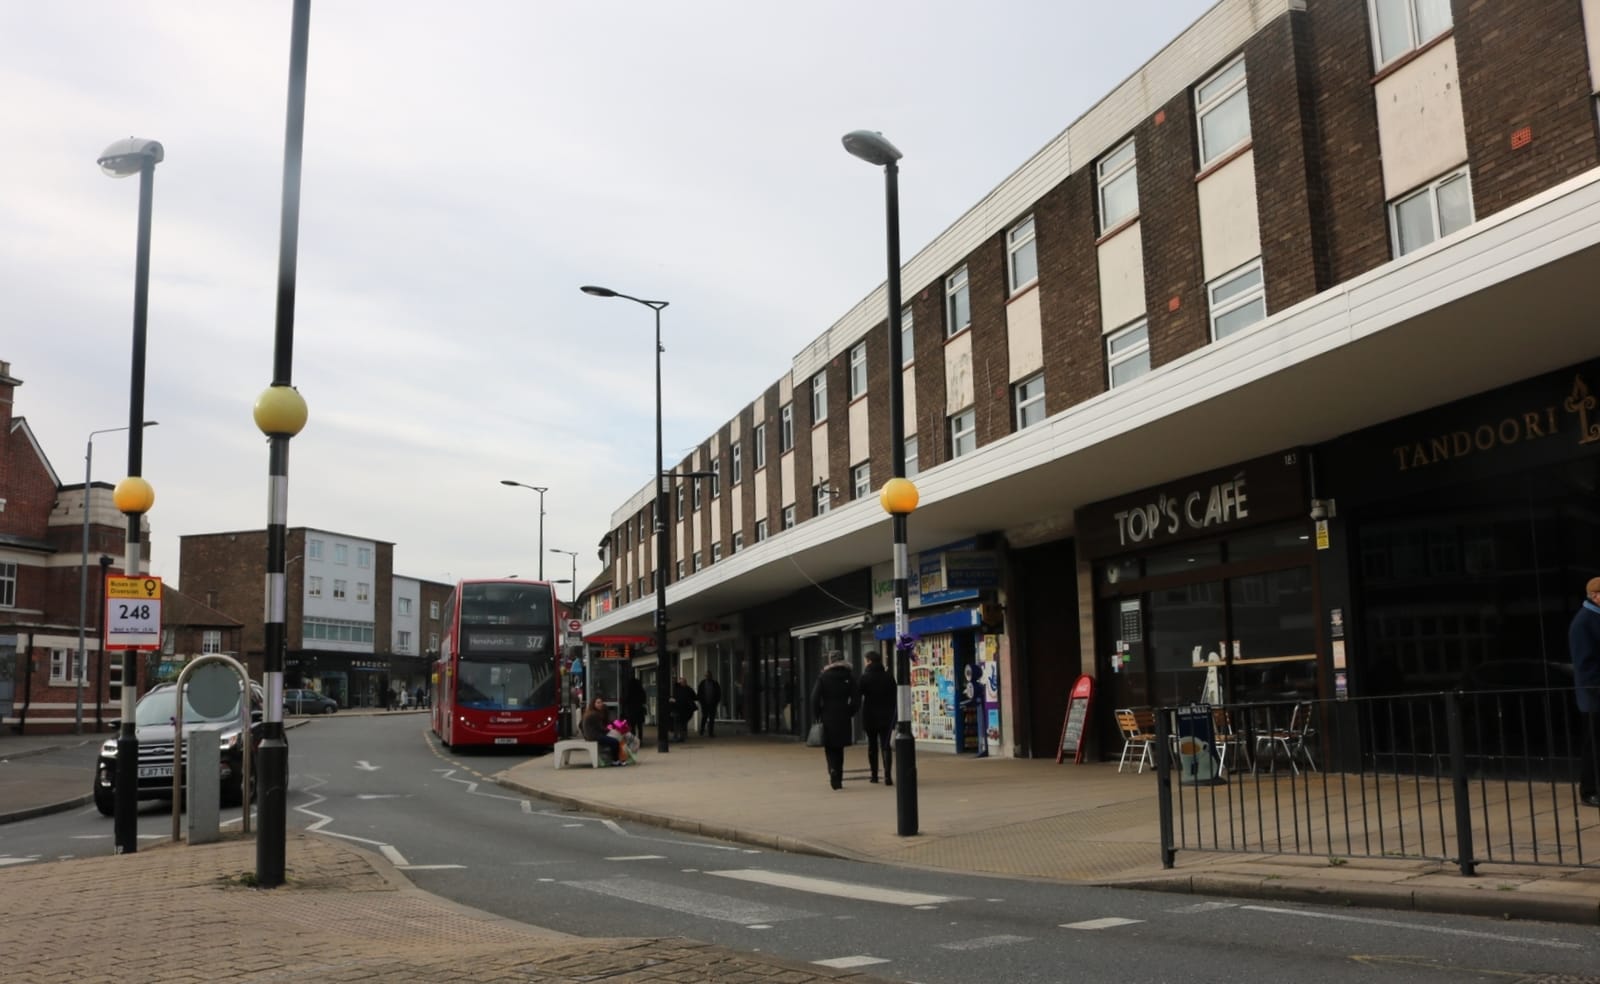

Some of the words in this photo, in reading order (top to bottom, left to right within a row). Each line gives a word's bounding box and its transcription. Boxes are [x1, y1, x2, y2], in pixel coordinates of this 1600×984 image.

[1393, 406, 1559, 471] TANDOORI
[1113, 493, 1180, 546] TOP'S
[1184, 470, 1249, 529] CAFÉ
[119, 604, 150, 620] 248
[527, 635, 544, 648] 372
